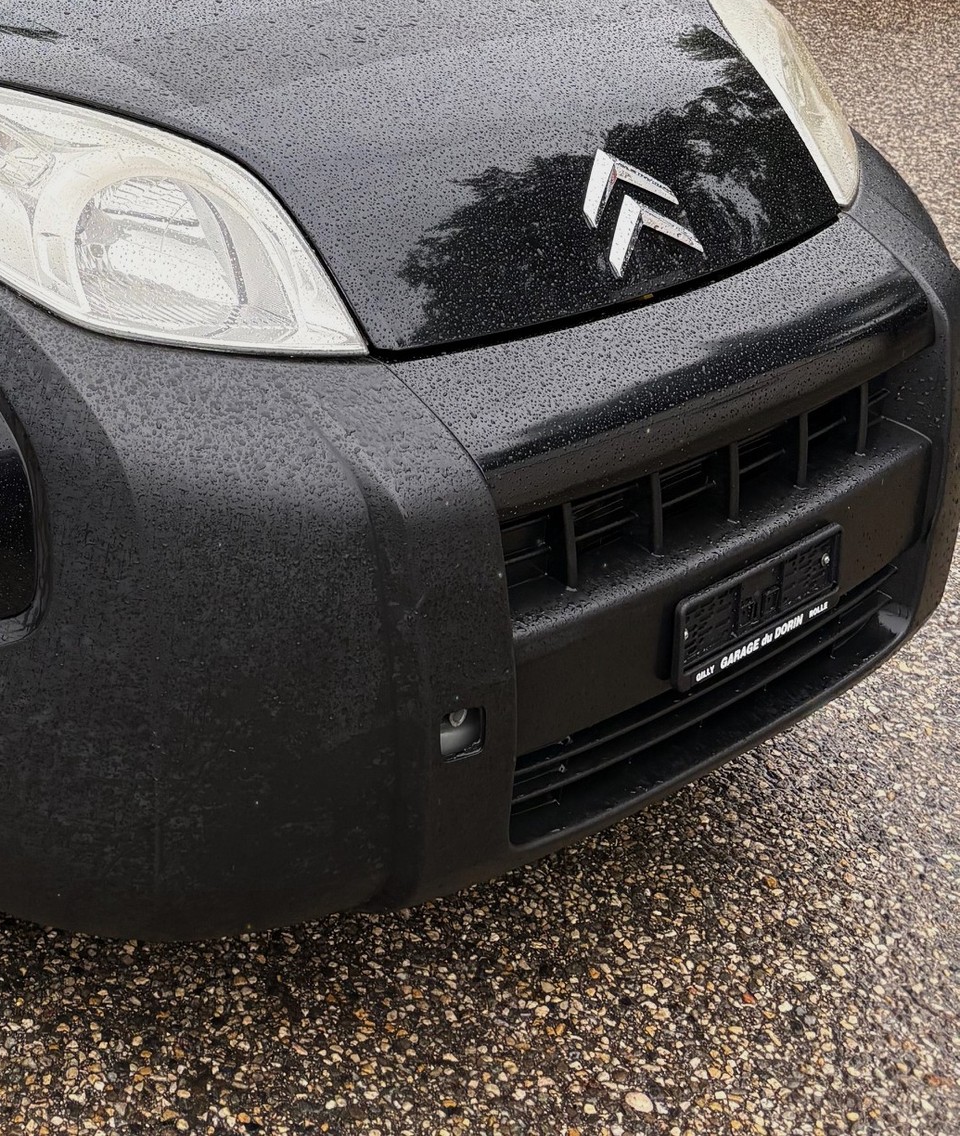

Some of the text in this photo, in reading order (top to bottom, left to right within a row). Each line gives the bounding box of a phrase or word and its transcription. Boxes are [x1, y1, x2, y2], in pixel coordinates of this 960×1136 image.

[695, 664, 716, 682] GILLY
[720, 638, 760, 669] GARAGE
[761, 632, 773, 648] du
[774, 614, 804, 640] DORIN
